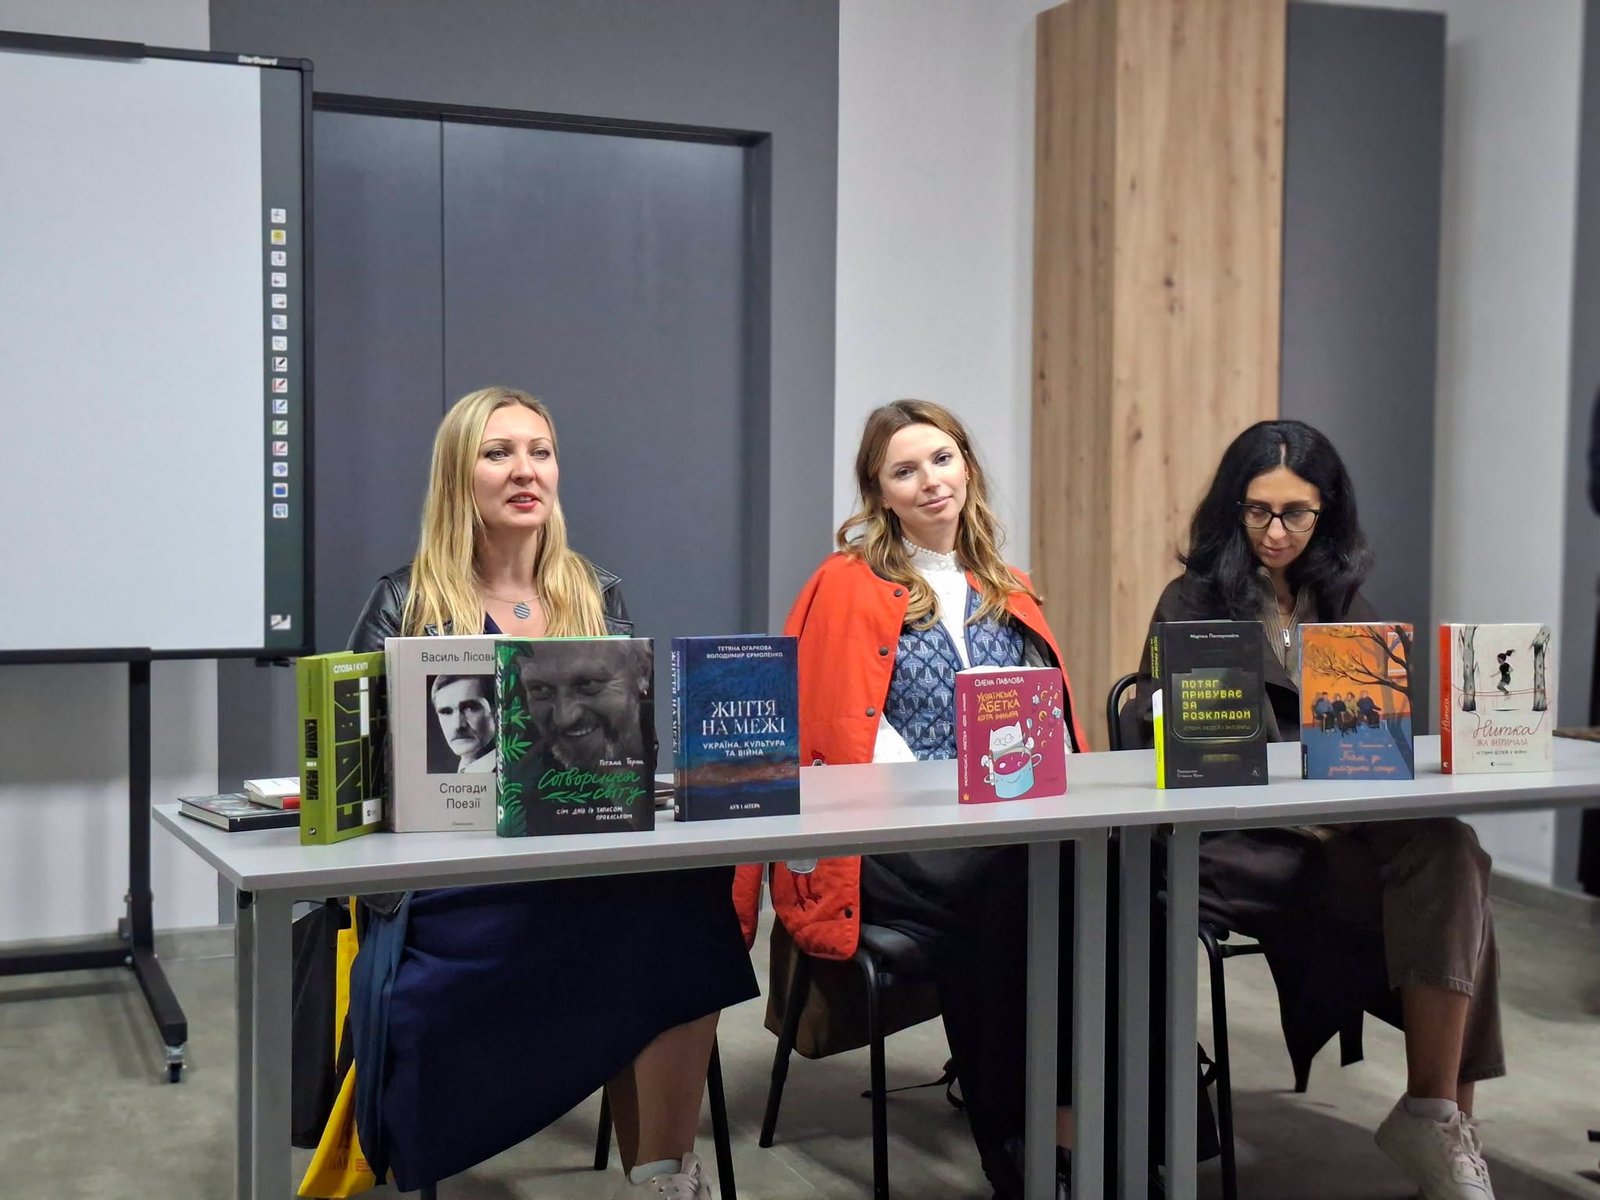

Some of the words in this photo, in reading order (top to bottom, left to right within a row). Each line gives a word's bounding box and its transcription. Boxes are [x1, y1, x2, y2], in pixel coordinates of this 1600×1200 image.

[421, 652, 460, 662] Василь
[974, 678, 995, 687] ОЛЕНА
[996, 676, 1024, 685] ПАВЛОВА
[1182, 680, 1219, 688] ПОТЯГ
[976, 689, 1018, 703] УКРАЇНСЬКА
[1182, 690, 1242, 699] ПРИБУВАЄ
[711, 700, 776, 718] ЖИТТЯ
[978, 698, 1020, 713] АБЕТКА
[1182, 701, 1197, 710] ЗА
[1182, 710, 1251, 720] РОЗКЛАДОМ
[702, 719, 728, 736] НА
[734, 717, 785, 735] МЕЖІ
[1473, 719, 1536, 738] Нитка
[744, 739, 786, 748] КУЛЬТУРА
[738, 748, 764, 757] ВІЙНА
[538, 767, 640, 791] Сотворіння
[440, 782, 487, 794] Спогади
[446, 797, 480, 809] Поезії
